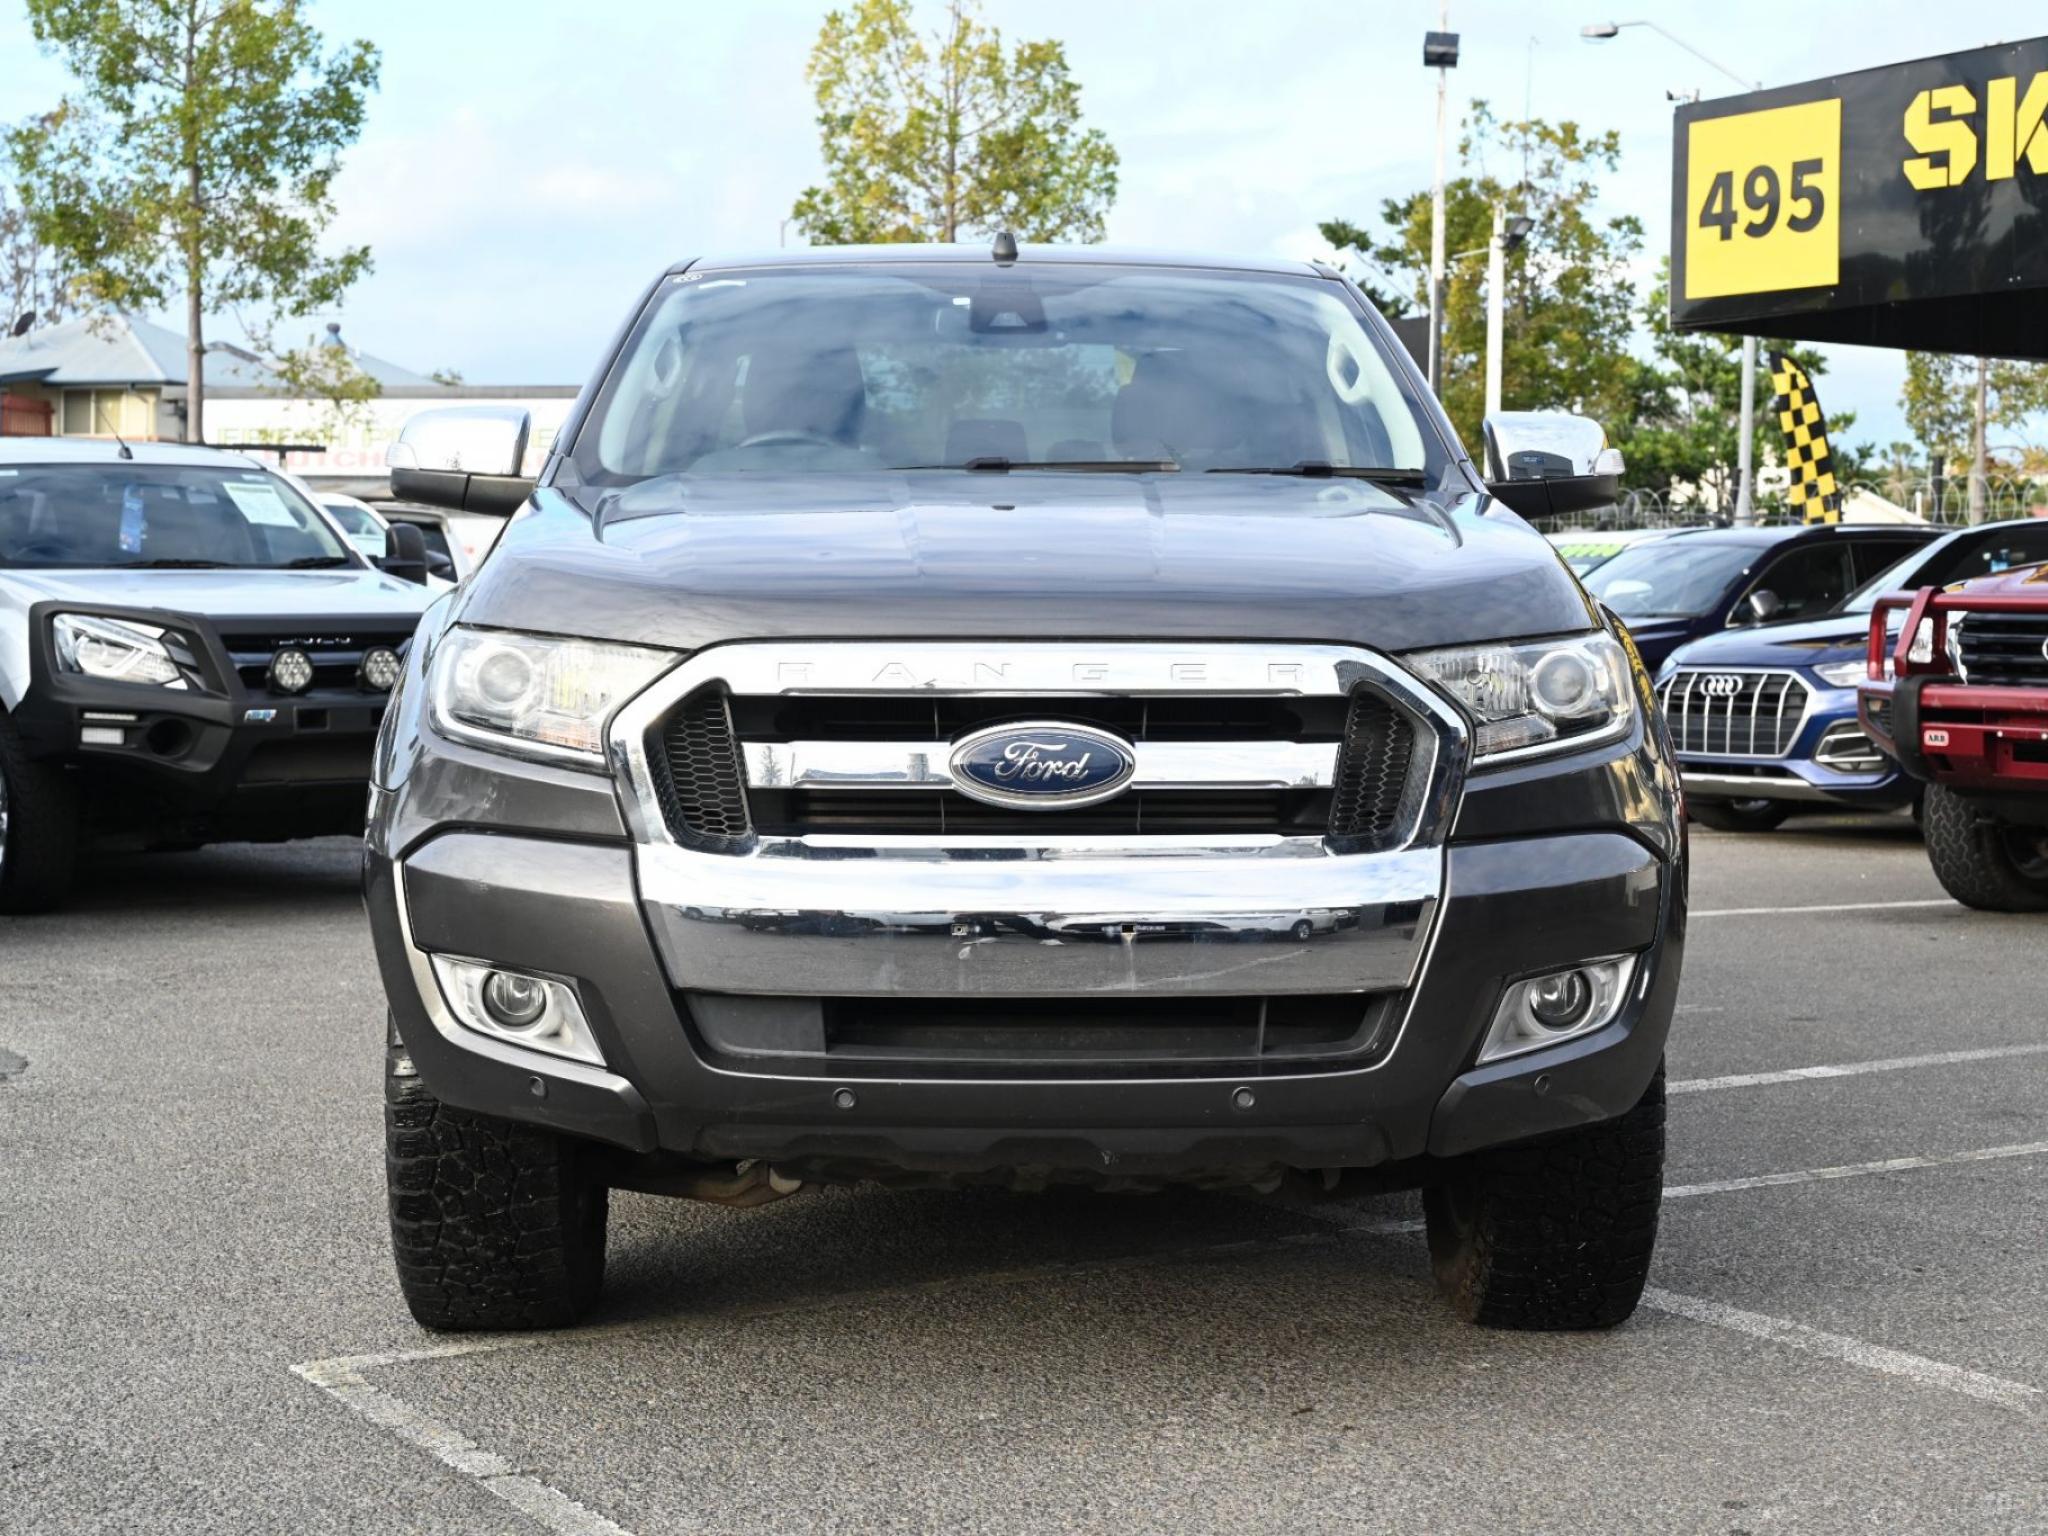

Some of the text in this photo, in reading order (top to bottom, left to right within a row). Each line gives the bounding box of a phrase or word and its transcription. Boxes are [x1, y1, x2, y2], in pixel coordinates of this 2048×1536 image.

[1903, 71, 2048, 190] SK
[1699, 158, 1825, 241] 495
[777, 662, 1304, 683] RANGER
[994, 741, 1091, 781] Ford
